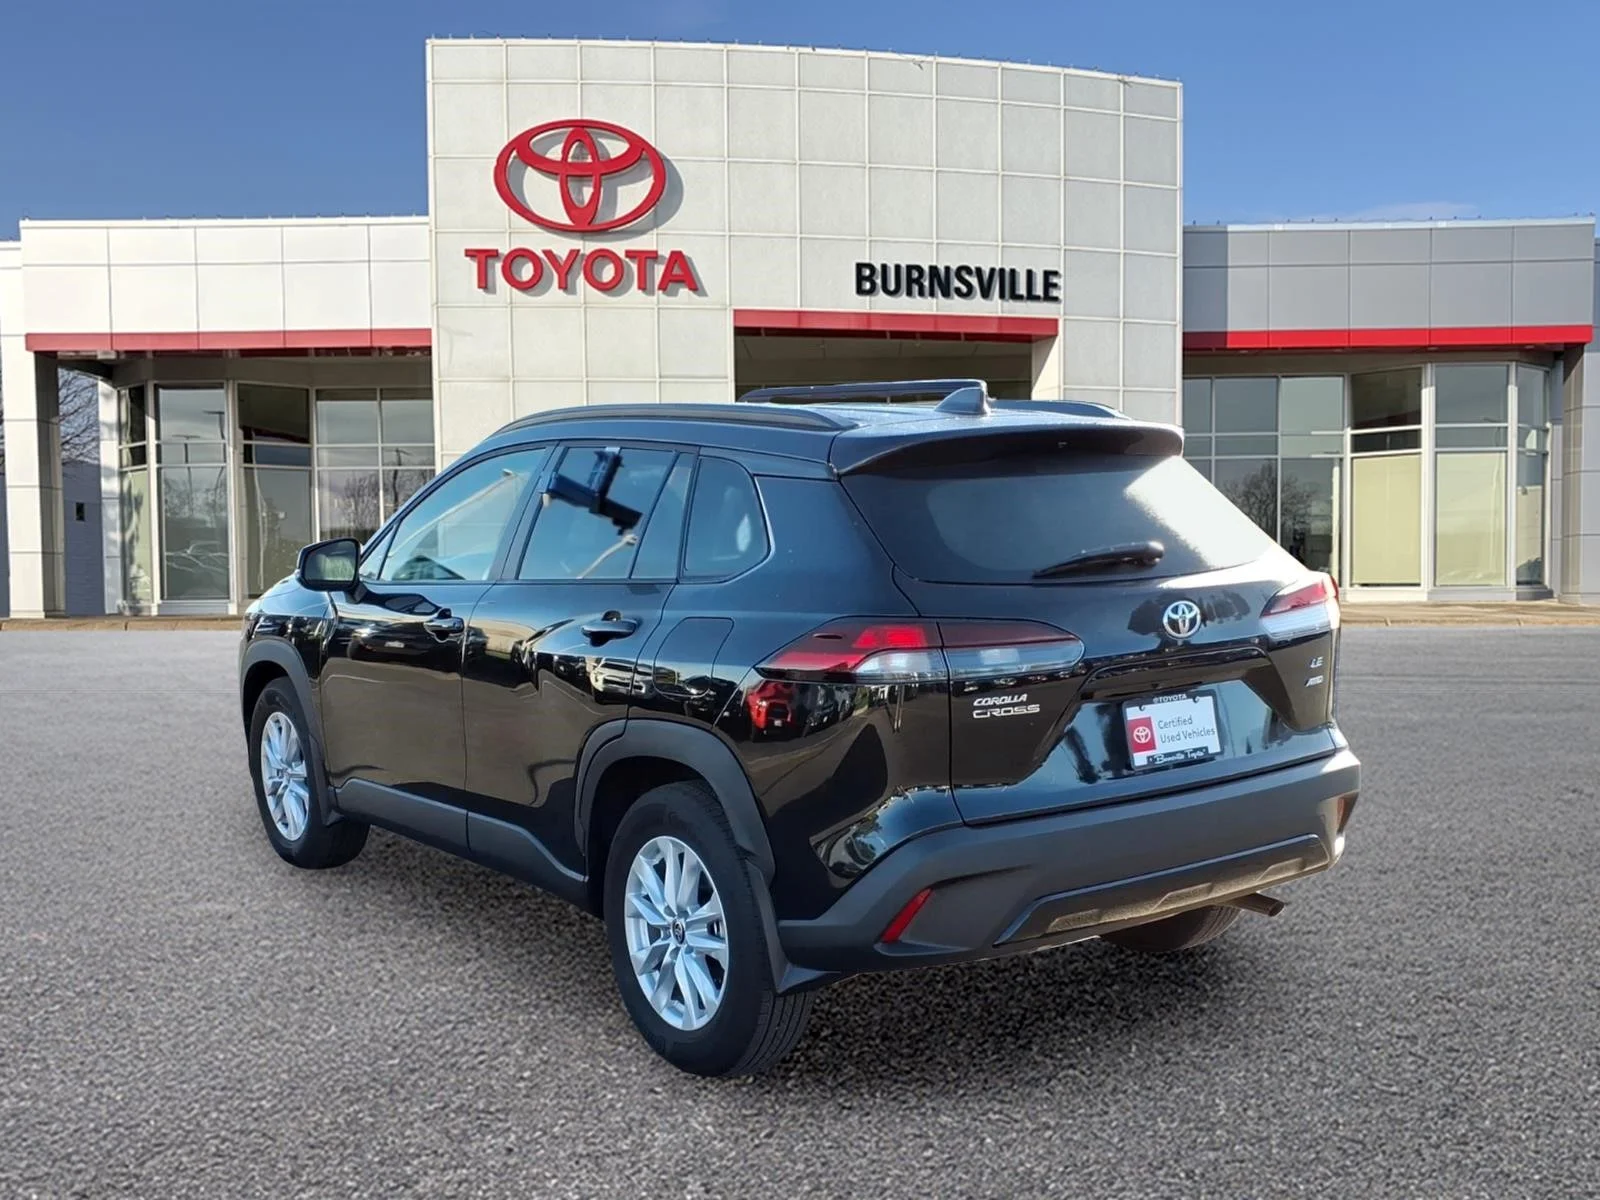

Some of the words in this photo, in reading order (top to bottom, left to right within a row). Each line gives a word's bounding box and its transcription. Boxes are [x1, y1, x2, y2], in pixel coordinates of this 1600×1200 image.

[465, 247, 699, 292] TOYOTA
[855, 262, 1062, 302] BURNSVILLE
[973, 693, 1028, 706] COROLLA
[1159, 693, 1187, 703] TOYOTA
[973, 704, 1040, 718] CROSS
[1157, 714, 1193, 730] Certified
[1160, 731, 1181, 743] Used
[1181, 727, 1216, 740] Vehicles
